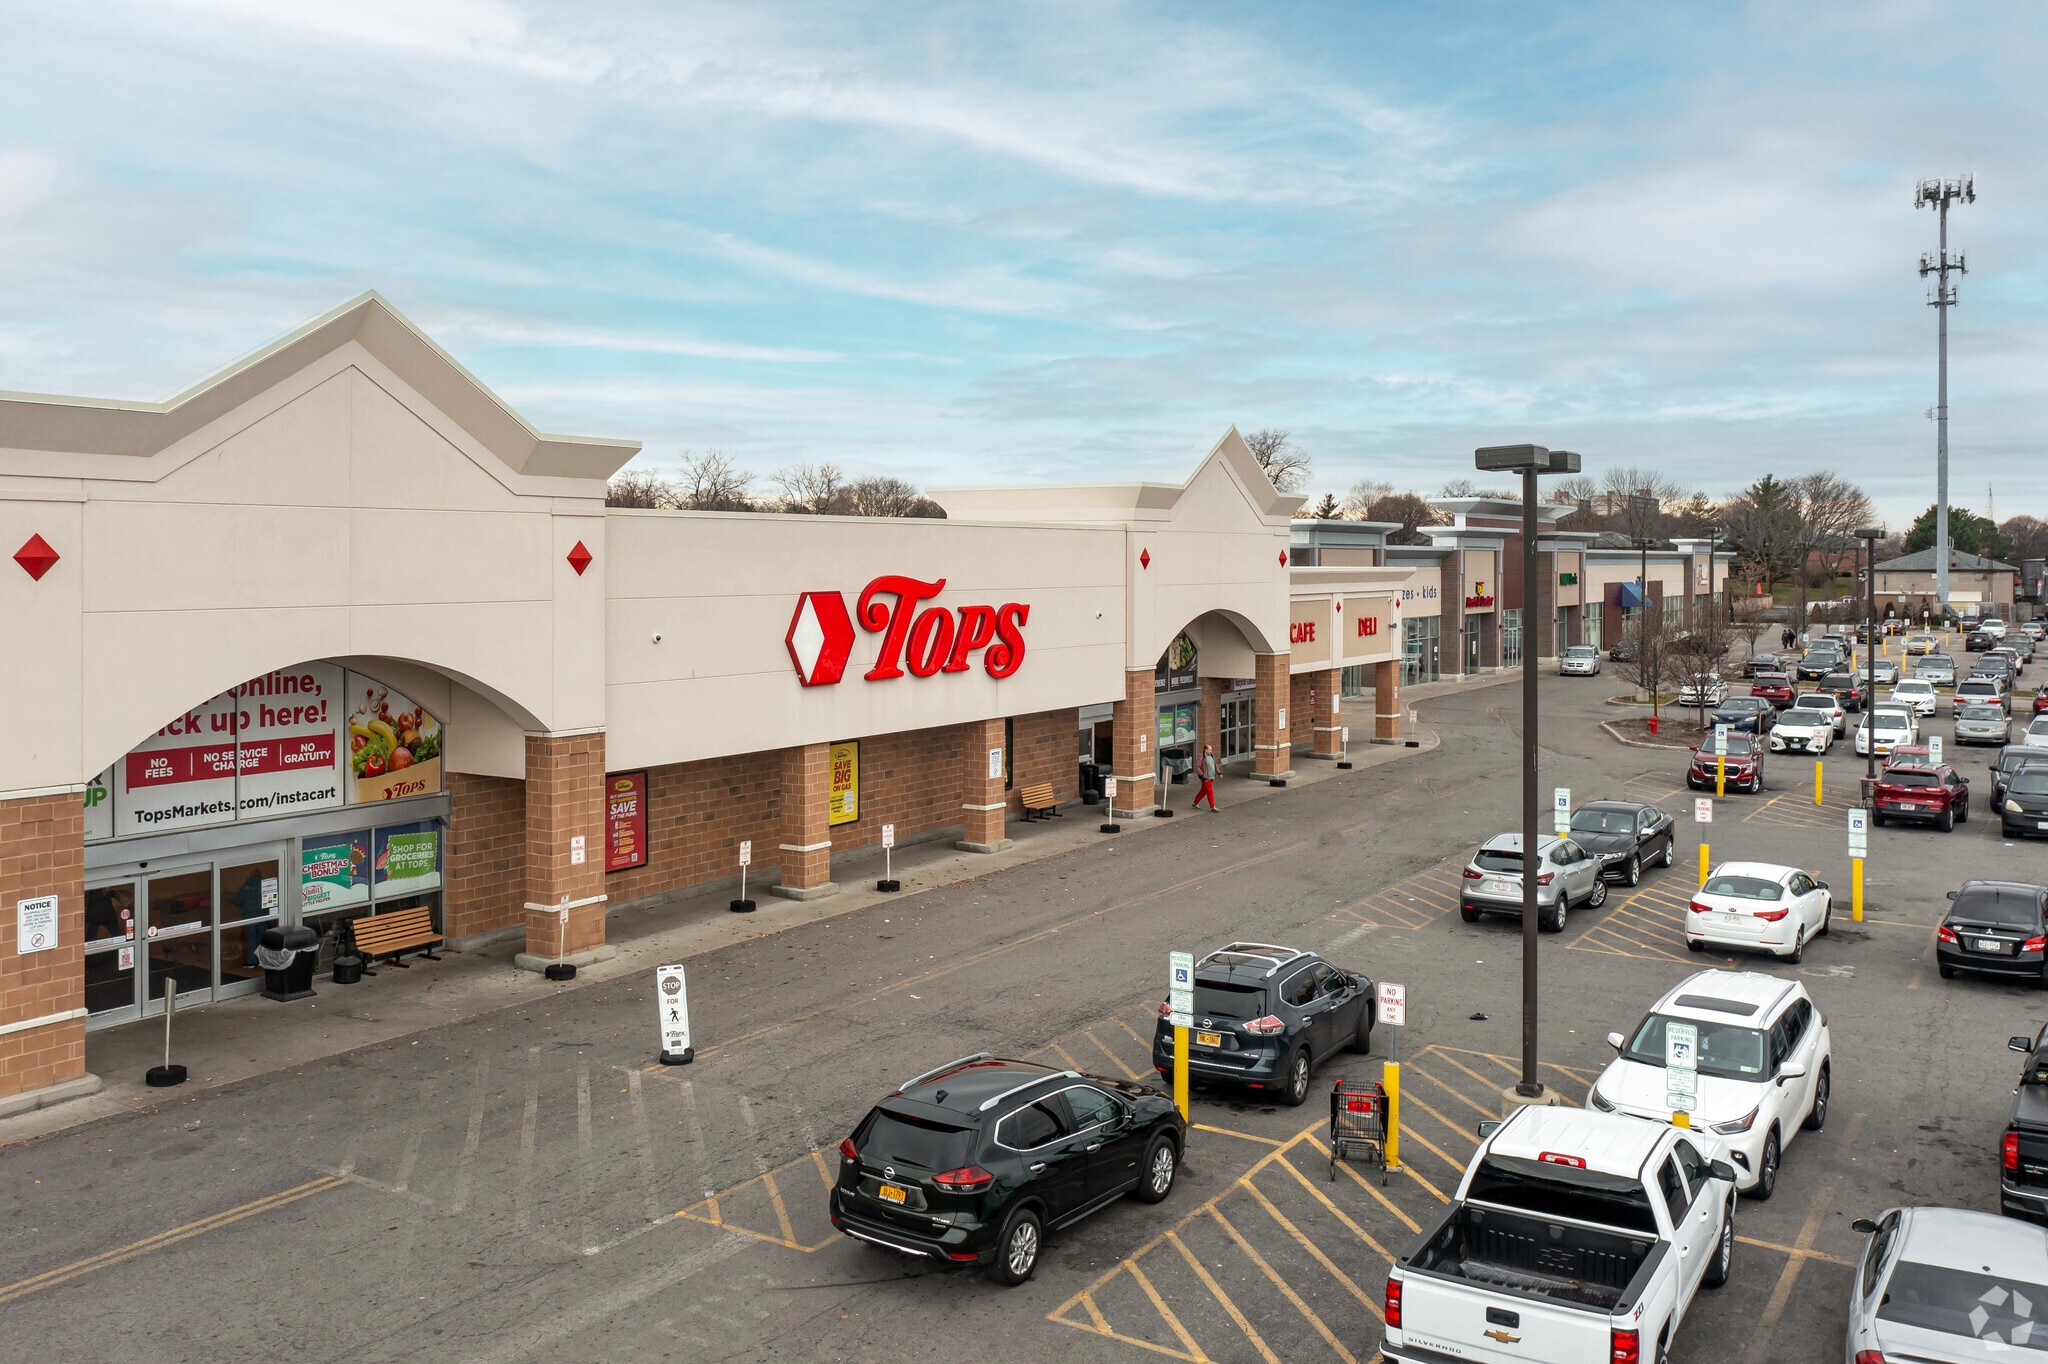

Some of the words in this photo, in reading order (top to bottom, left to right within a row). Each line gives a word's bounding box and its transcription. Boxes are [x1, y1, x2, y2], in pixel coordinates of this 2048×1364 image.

[1423, 585, 1436, 598] kids
[1290, 622, 1315, 643] CAFE
[1358, 617, 1377, 637] DELI
[210, 710, 250, 735] up
[260, 700, 327, 727] here!
[300, 743, 315, 752] NO
[203, 753, 219, 762] NO
[222, 747, 268, 761] SERVICE
[284, 751, 331, 764] GRATUITY
[150, 757, 168, 768] NO
[213, 758, 259, 771] CHARGE
[834, 760, 851, 770] SAVE
[145, 767, 173, 779] FEES
[834, 769, 851, 785] BIG
[135, 786, 336, 824] TopsMarkets.com/instacart
[610, 800, 637, 815] SAVE
[393, 844, 414, 853] SHOP
[416, 842, 432, 851] FOR
[390, 851, 434, 862] GROCERIES
[302, 860, 348, 873] CHRISTMAS
[395, 862, 406, 870] AT
[312, 867, 339, 878] BONUS
[25, 901, 51, 911] NOTICE
[663, 982, 680, 990] STOP
[1387, 988, 1396, 996] NO
[1381, 997, 1402, 1006] PARKING
[1668, 1027, 1695, 1036] RESERVED
[1671, 1034, 1692, 1043] PARKING
[1408, 1336, 1462, 1354] SILVERADO
